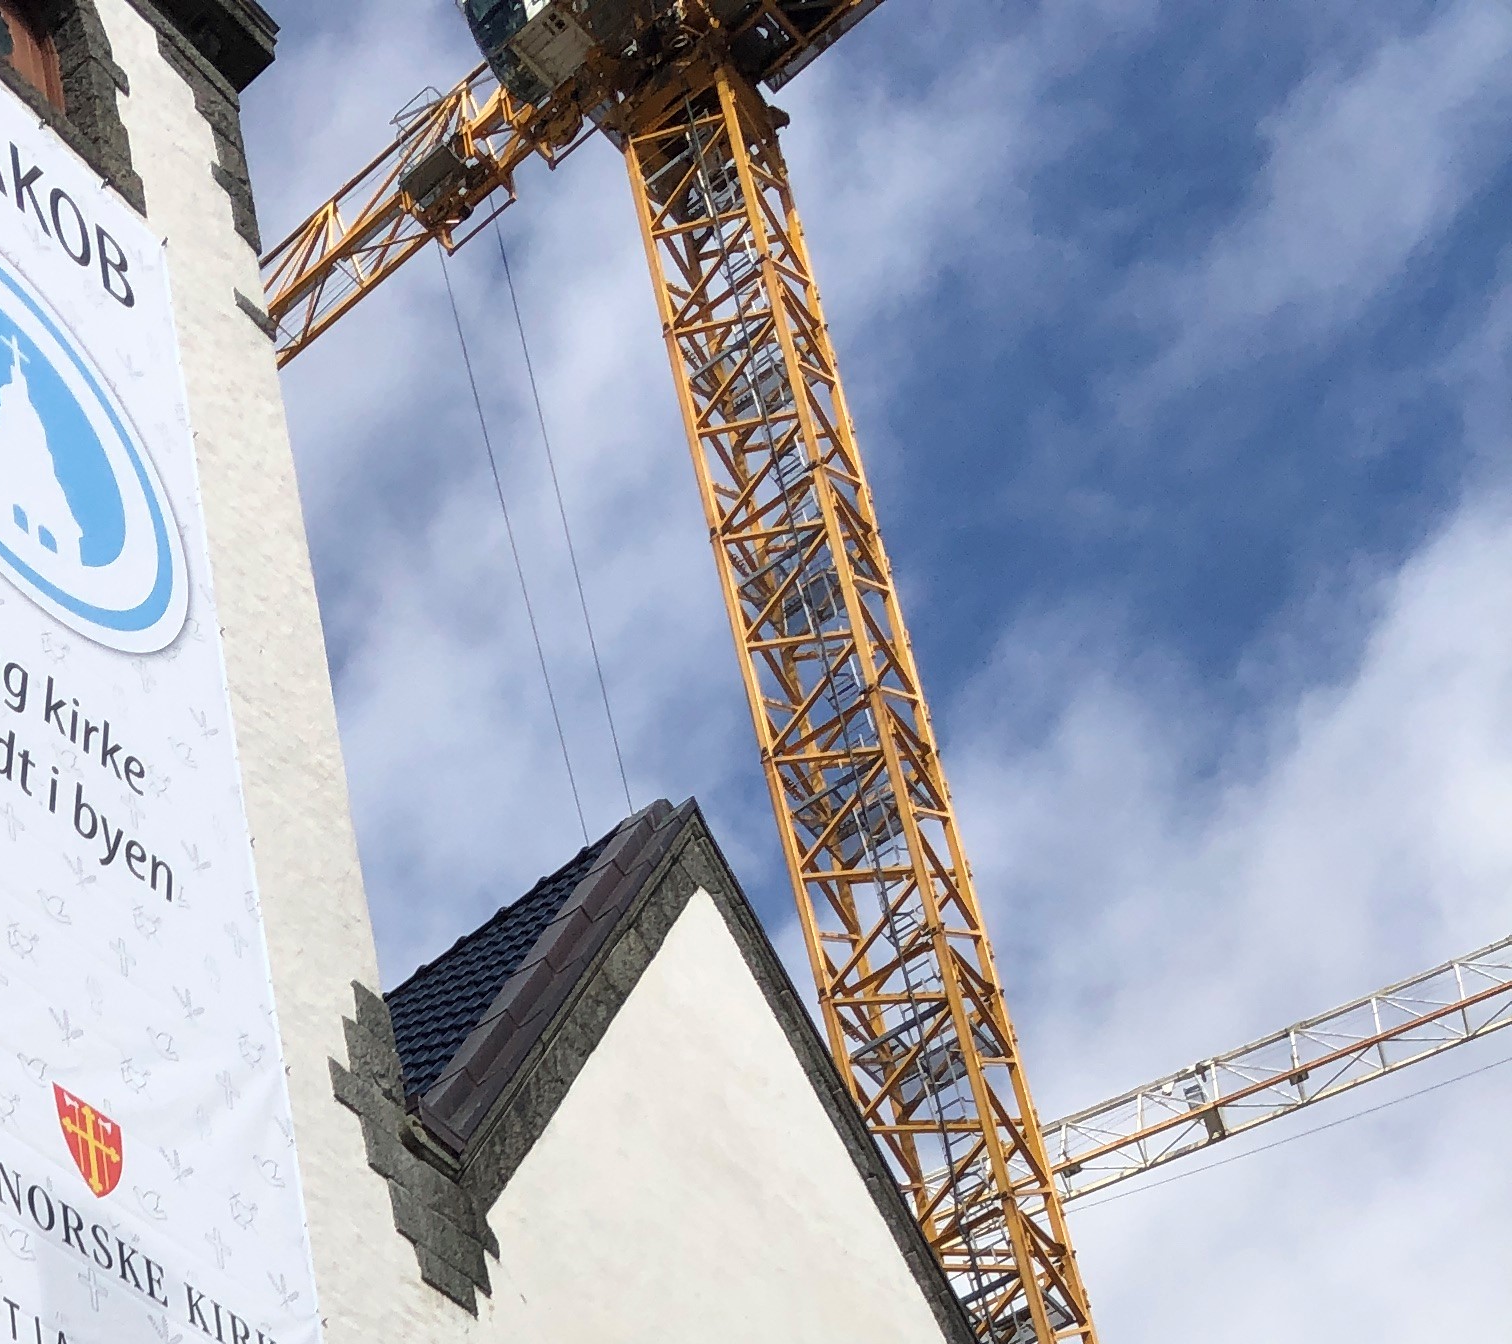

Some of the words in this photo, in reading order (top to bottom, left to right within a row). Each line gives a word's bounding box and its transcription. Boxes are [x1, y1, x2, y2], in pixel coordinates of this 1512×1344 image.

[44, 675, 145, 796] kirke
[49, 766, 59, 814] i
[74, 782, 173, 902] byen
